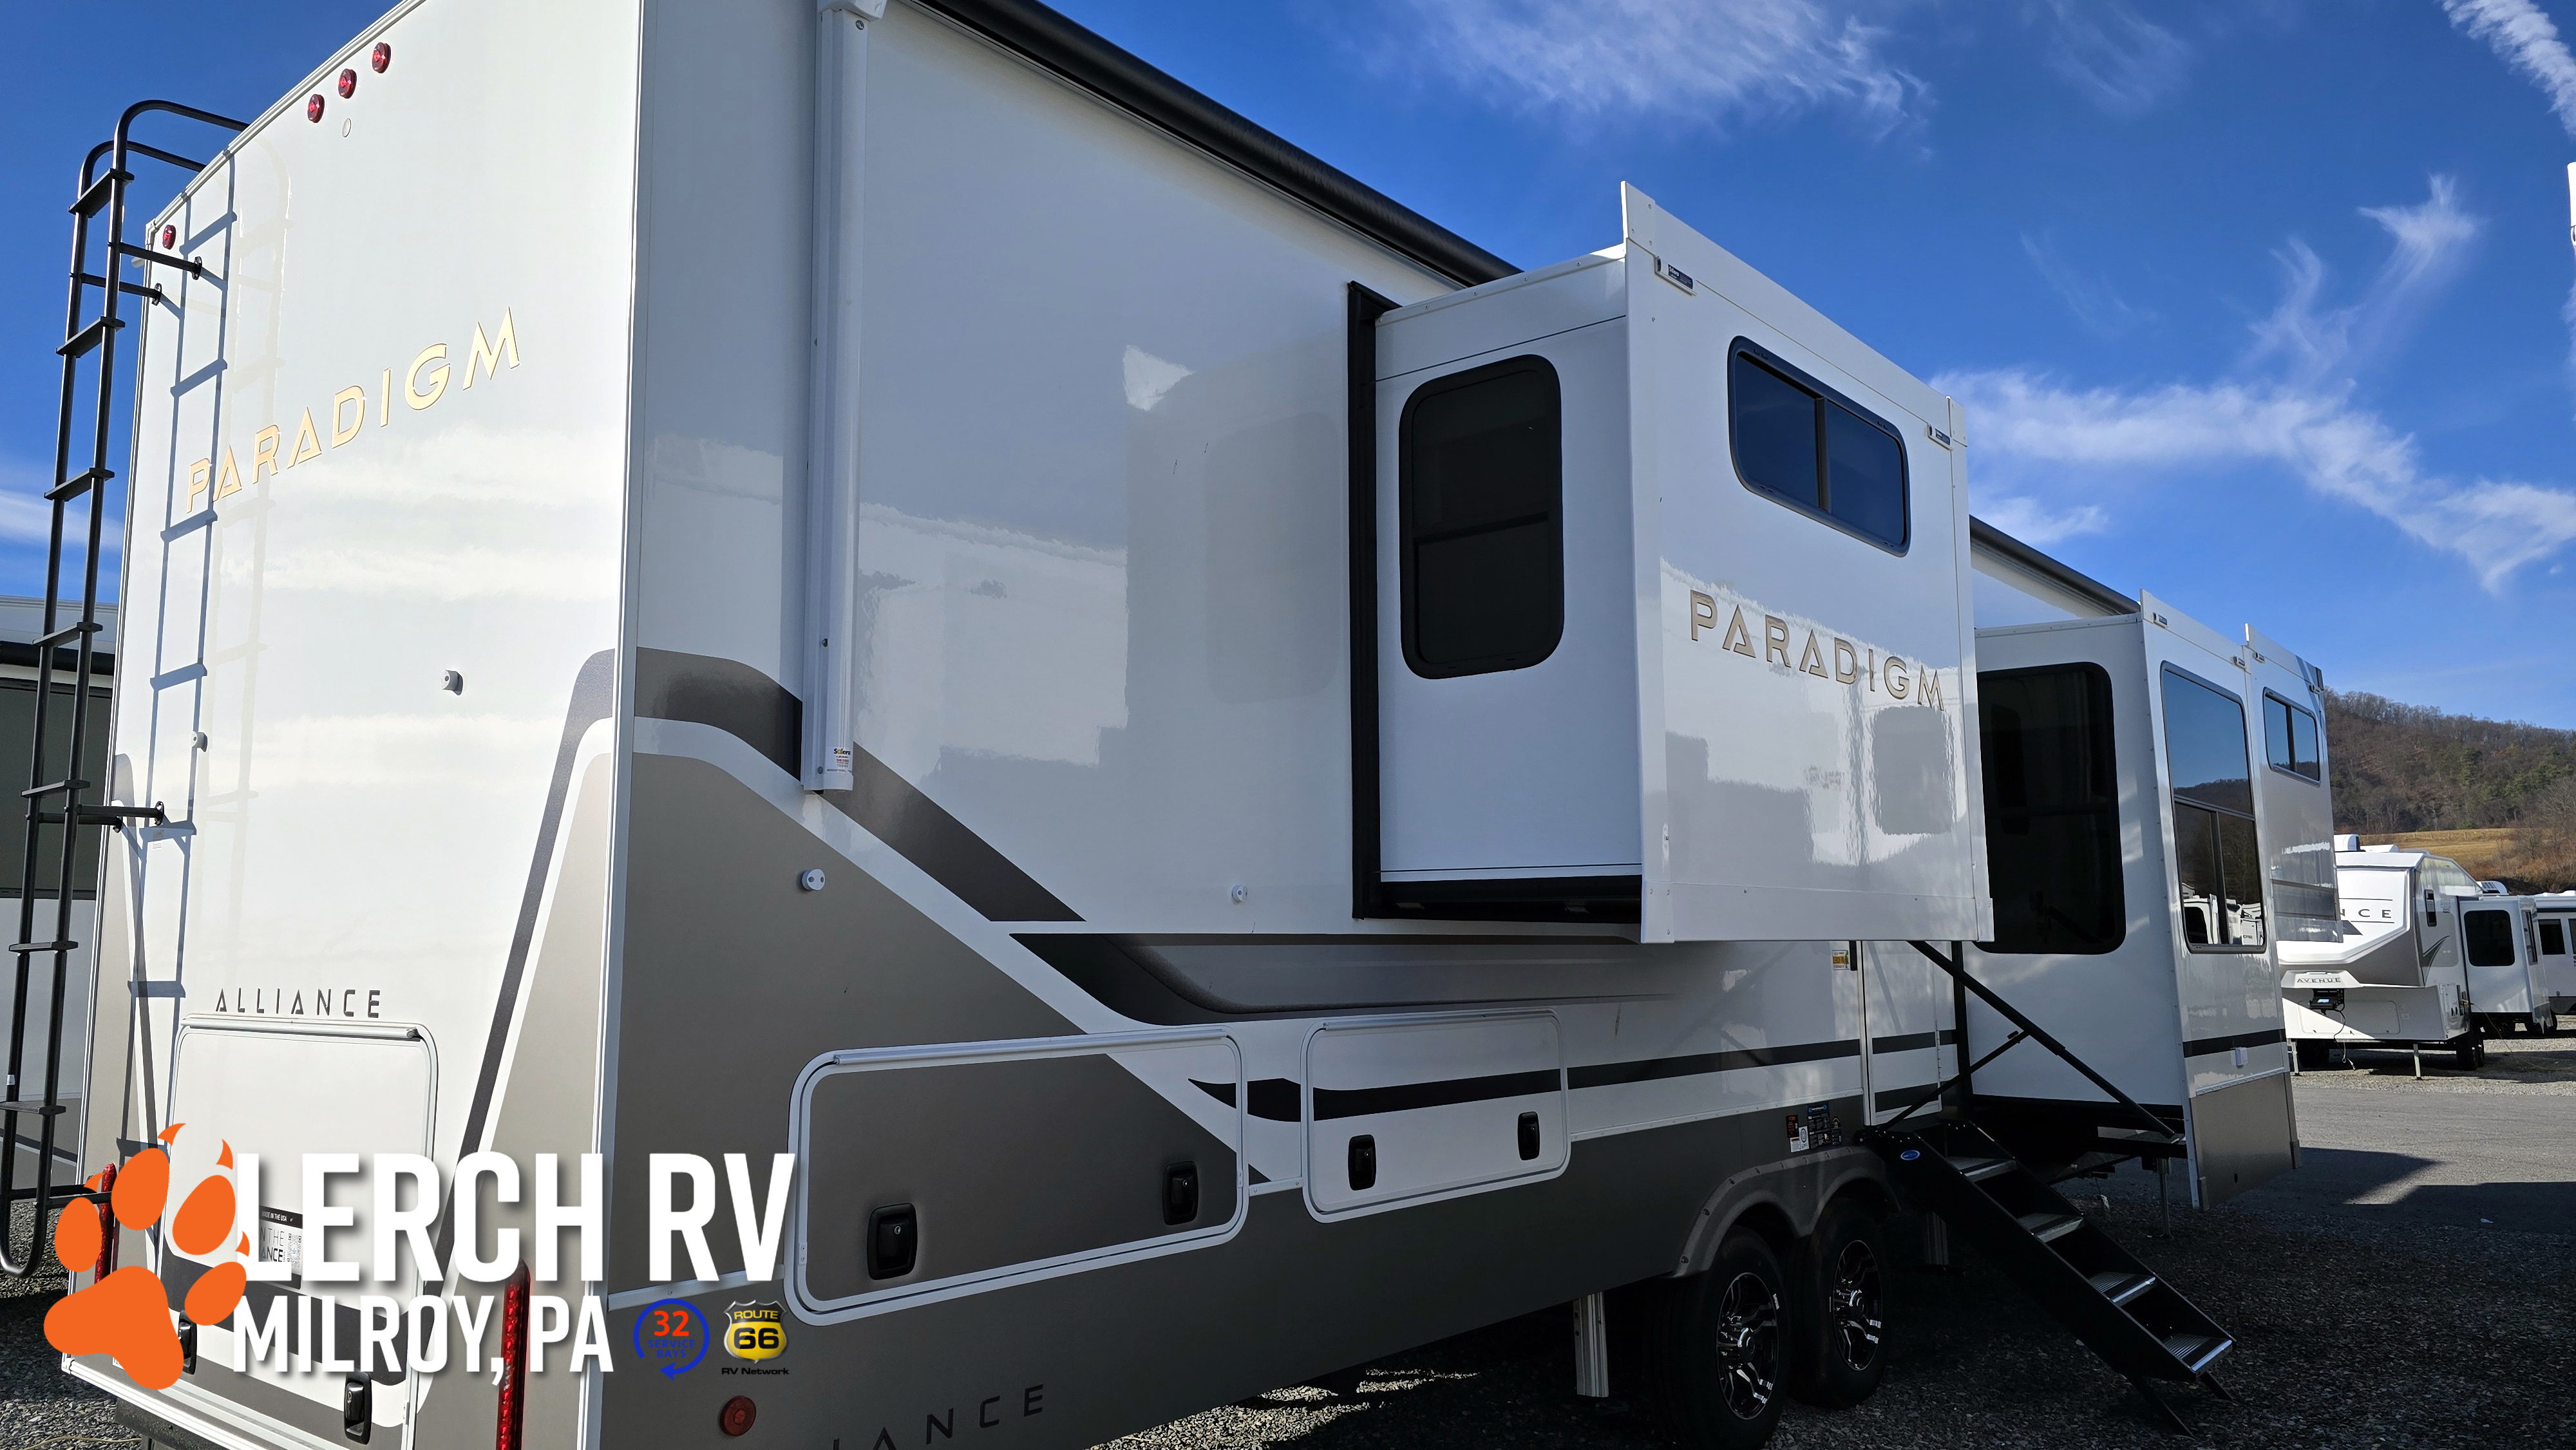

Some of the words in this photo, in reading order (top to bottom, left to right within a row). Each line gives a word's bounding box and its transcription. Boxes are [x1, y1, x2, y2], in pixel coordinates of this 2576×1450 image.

[186, 306, 520, 514] PARADIGM
[1690, 589, 1944, 711] PARADIGM
[216, 988, 380, 1018] ALLIANCE
[833, 1384, 1044, 1450] ANCE
